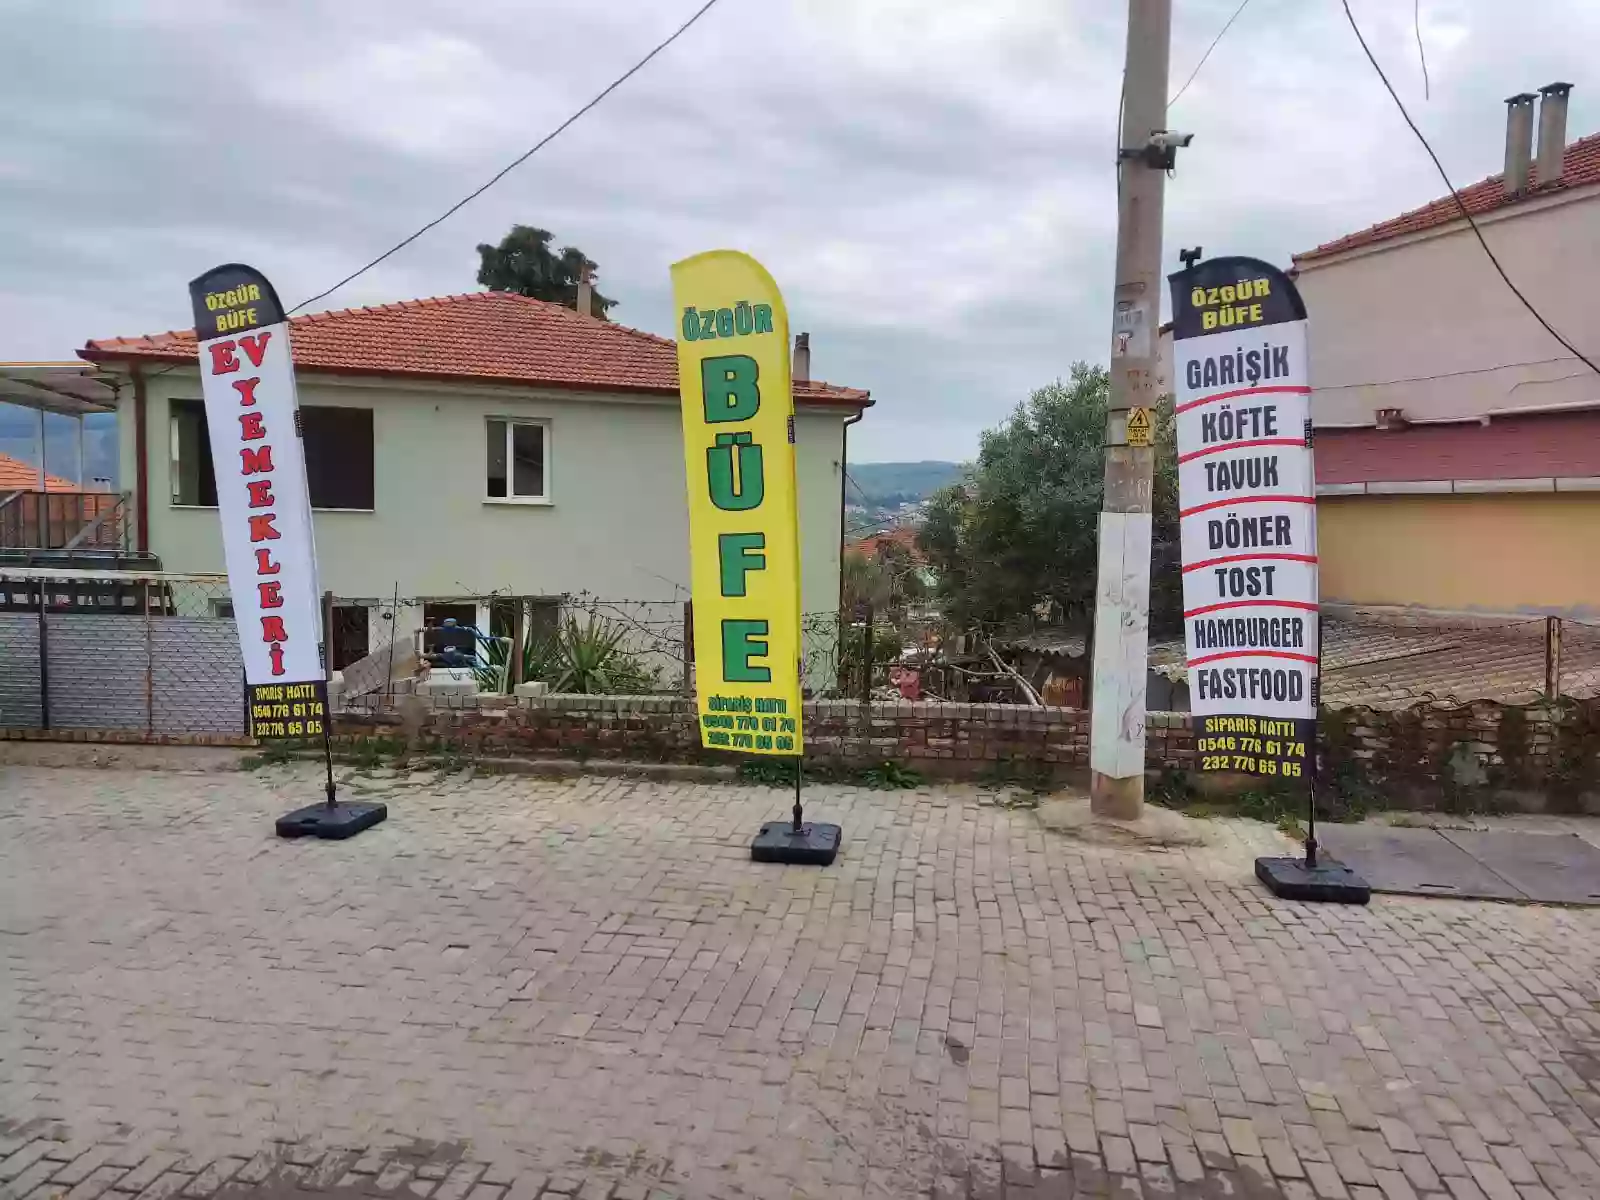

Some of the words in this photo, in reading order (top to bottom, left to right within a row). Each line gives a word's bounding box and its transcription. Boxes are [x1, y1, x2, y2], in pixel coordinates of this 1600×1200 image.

[205, 283, 261, 311] ÖZGÜR
[1191, 277, 1271, 307] ÖZGÜR
[215, 307, 258, 332] BÜFE
[681, 300, 774, 342] ÖZGÜR
[1202, 304, 1264, 330] BÜFE
[207, 331, 272, 376] EV
[1186, 342, 1290, 390] GARİŞİK
[1201, 404, 1279, 443] KÖFTE
[1204, 455, 1279, 492] TAVUK
[231, 376, 288, 676] YEMEKLERİ
[700, 354, 771, 682] BÜFE
[1207, 512, 1293, 550] DÖNER
[1214, 565, 1276, 598] TOST
[1194, 617, 1304, 649] HAMBURGER
[1197, 667, 1303, 702] FASTFOOD
[293, 702, 306, 717] 61
[308, 702, 324, 717] 74
[288, 721, 303, 736] 65
[306, 720, 323, 734] 05
[1205, 716, 1257, 736] SİPARİŞ
[1259, 719, 1295, 737] HATTI
[1197, 737, 1236, 752] 0546
[1239, 737, 1262, 753] 776
[1266, 740, 1281, 756] 61
[1285, 742, 1306, 758] 74
[1202, 755, 1230, 770] 232
[1232, 756, 1256, 772] 776
[1258, 759, 1277, 775] 65
[1281, 761, 1302, 777] 05
